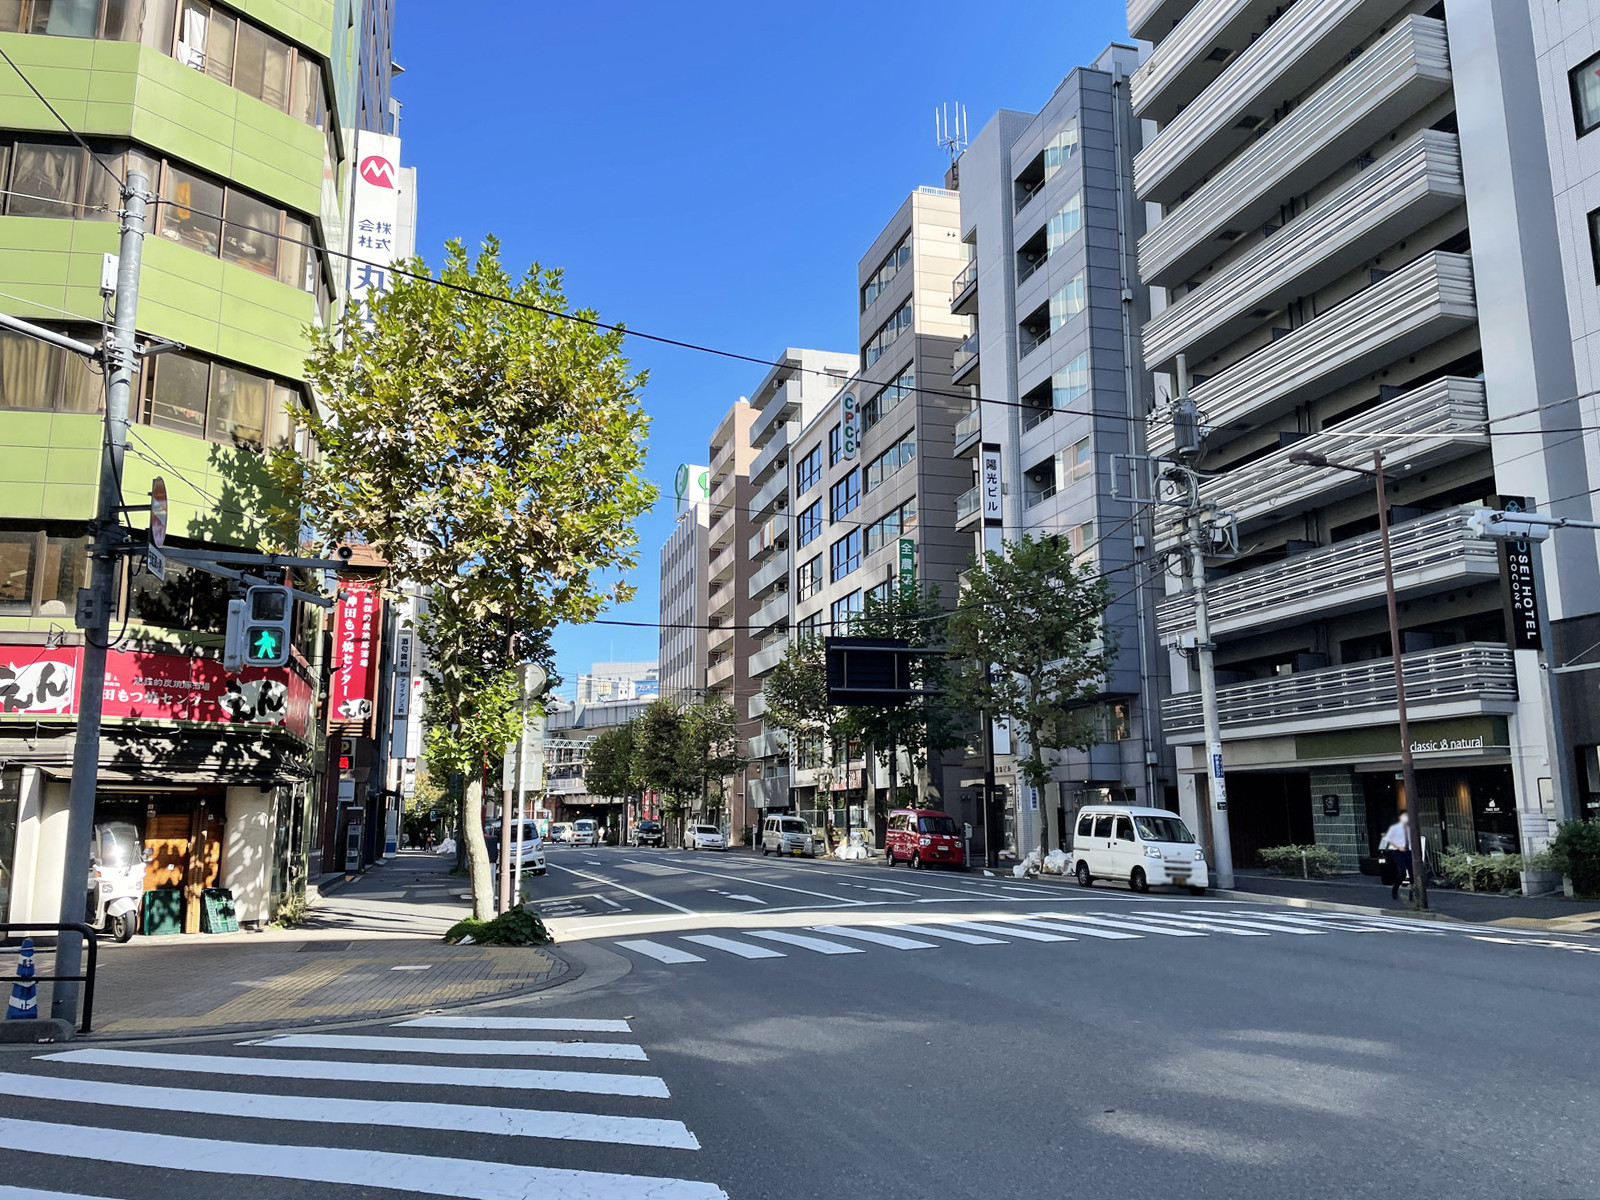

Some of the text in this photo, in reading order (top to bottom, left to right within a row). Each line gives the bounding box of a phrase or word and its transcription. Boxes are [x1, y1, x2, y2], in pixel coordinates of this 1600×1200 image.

[844, 396, 855, 454] CPCC
[985, 458, 998, 512] 陽光ビル
[1522, 586, 1537, 640] HOTEL
[0, 661, 69, 713] えん
[1409, 739, 1438, 752] classic
[1450, 735, 1484, 749] natural
